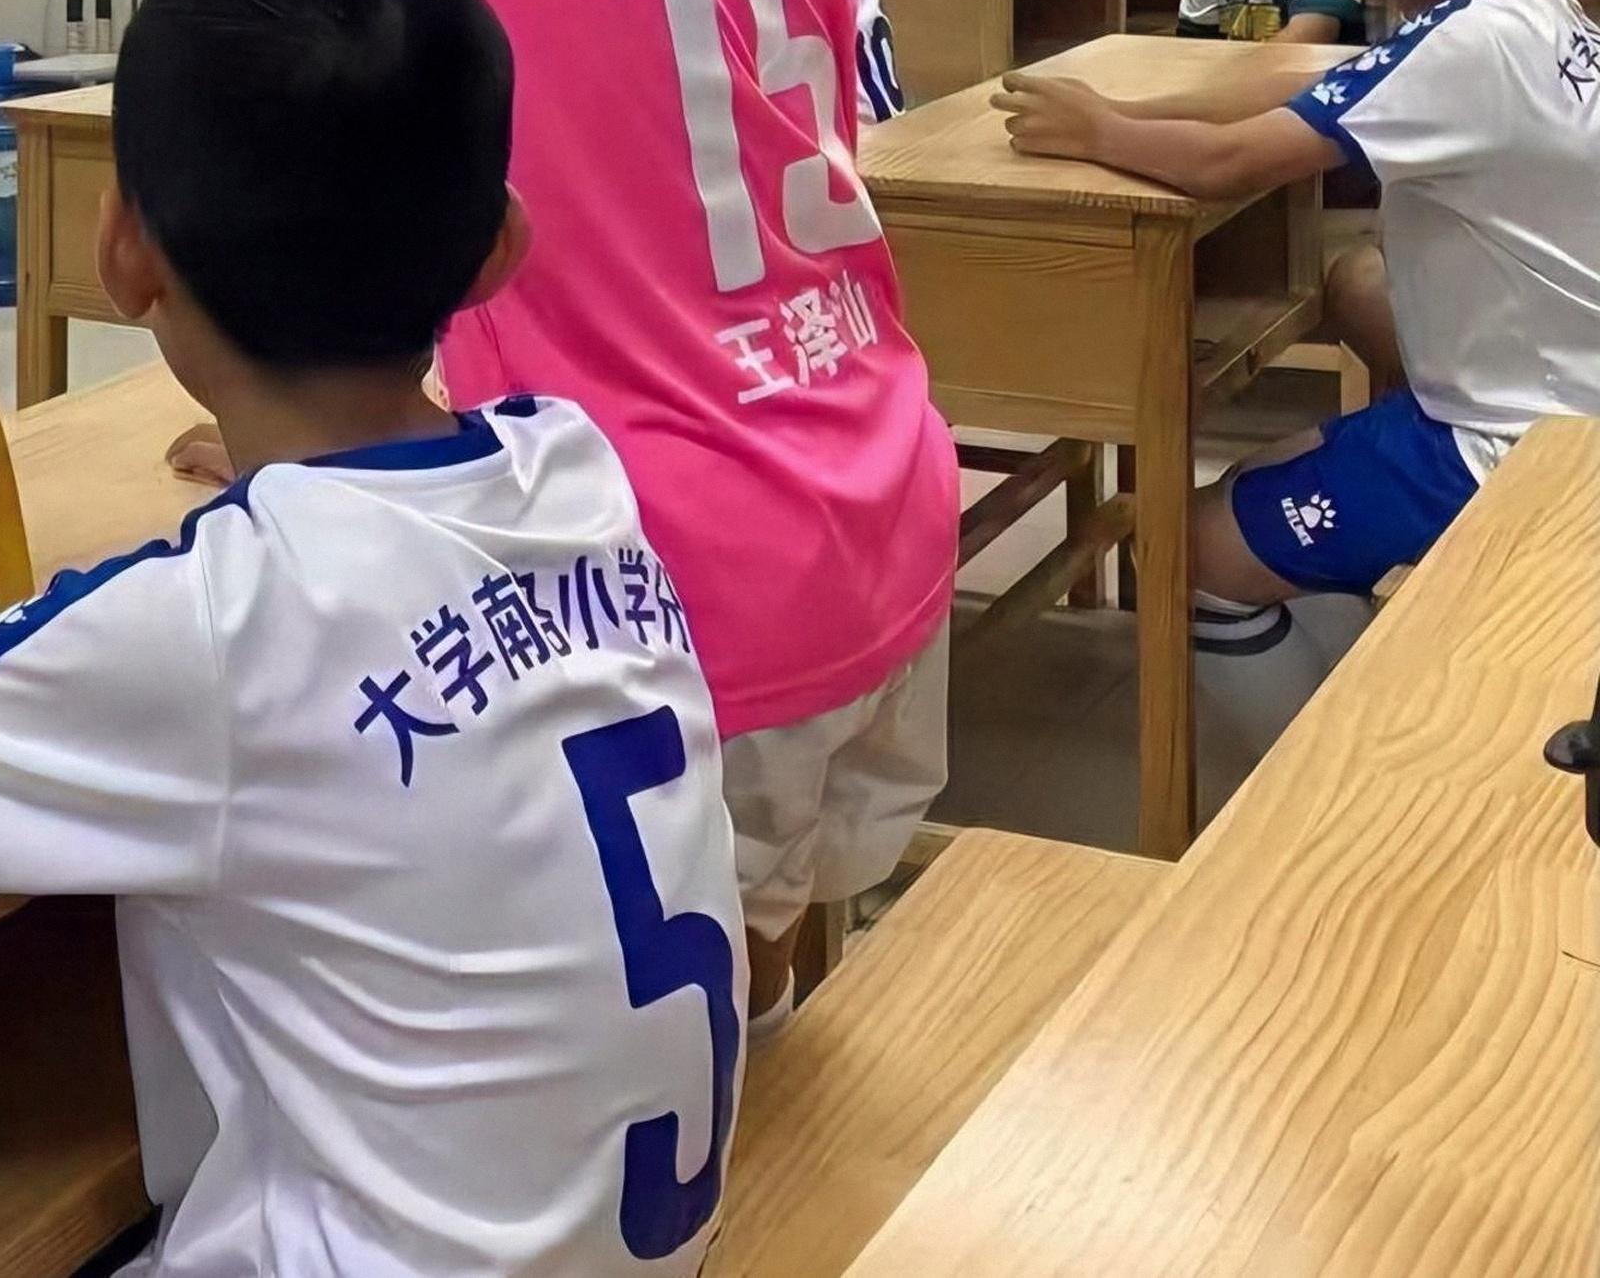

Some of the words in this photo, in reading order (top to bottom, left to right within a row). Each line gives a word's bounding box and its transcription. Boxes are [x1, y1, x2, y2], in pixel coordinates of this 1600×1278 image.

[714, 269, 879, 406] 王泽汕
[560, 704, 741, 1260] 5
